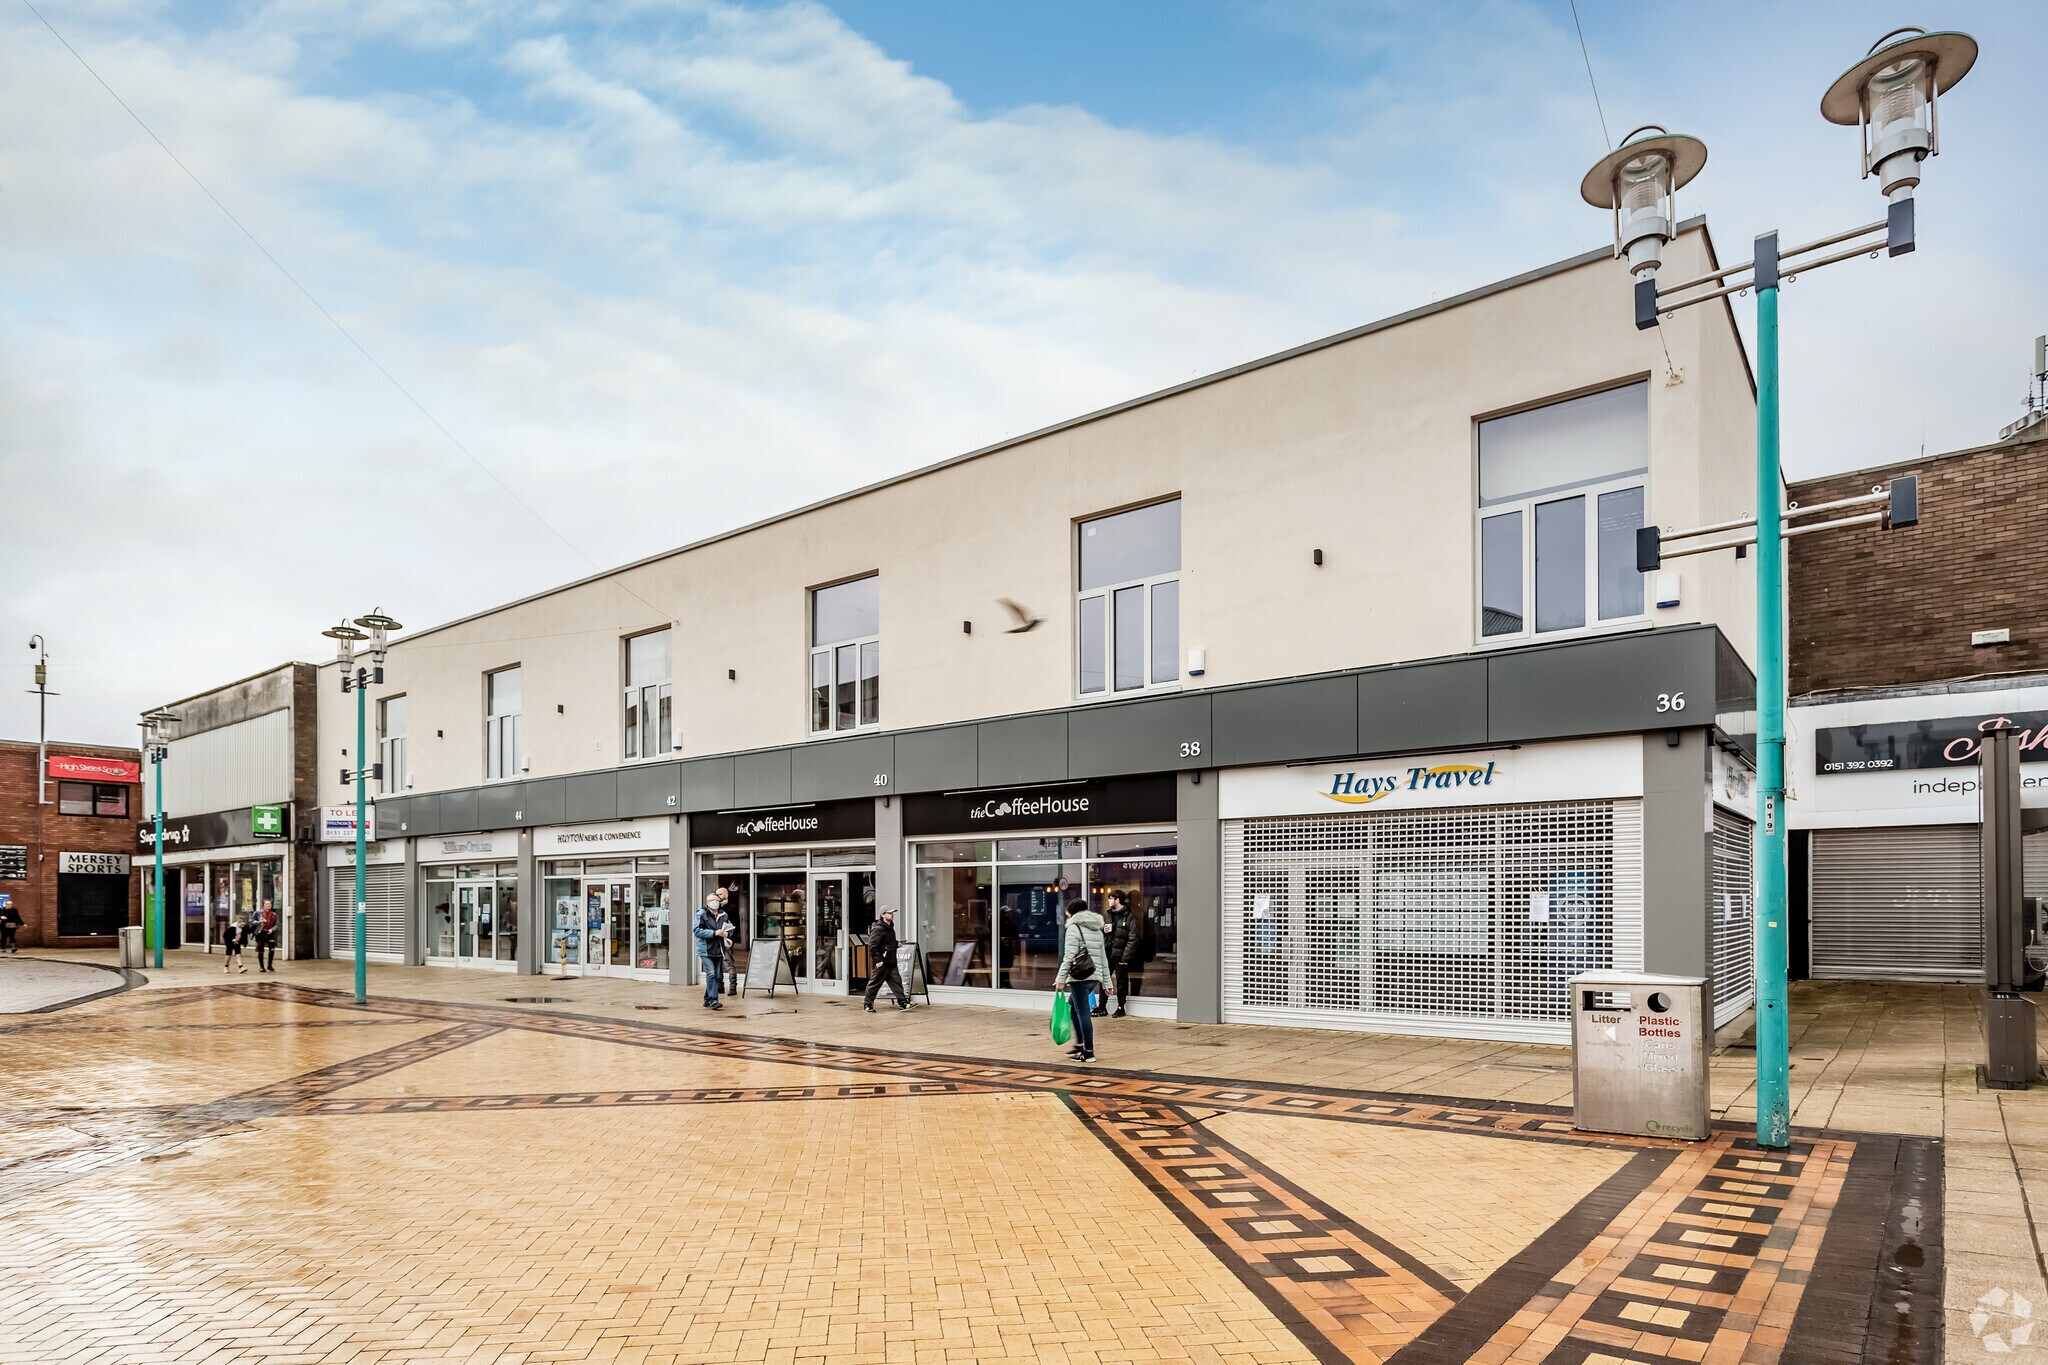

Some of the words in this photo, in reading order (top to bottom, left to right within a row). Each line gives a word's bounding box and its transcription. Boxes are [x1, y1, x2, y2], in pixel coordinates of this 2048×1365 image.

[1656, 692, 1686, 714] 36
[1179, 741, 1202, 758] 38
[1824, 762, 1845, 771] 0151
[1846, 761, 1866, 770] 392
[1867, 759, 1894, 769] 0392
[873, 774, 888, 787] 40
[1330, 771, 1397, 799] Hays
[1406, 761, 1495, 790] Travel
[666, 795, 676, 806] 42
[514, 810, 523, 821] 44
[557, 832, 583, 844] HUYTON
[584, 833, 598, 842] NEWS
[599, 833, 603, 841] &
[604, 831, 641, 841] CONVENIENCE
[68, 854, 122, 864] MERSEY
[68, 863, 122, 874] SPORTS
[1591, 1014, 1622, 1025] Litter
[1639, 1015, 1680, 1027] Plastic
[1638, 1027, 1681, 1038] Bottles
[1645, 1039, 1676, 1050] Cans
[1643, 1050, 1678, 1063] Mixed
[1643, 1063, 1679, 1074] Glass
[1661, 1123, 1694, 1134] recycle
